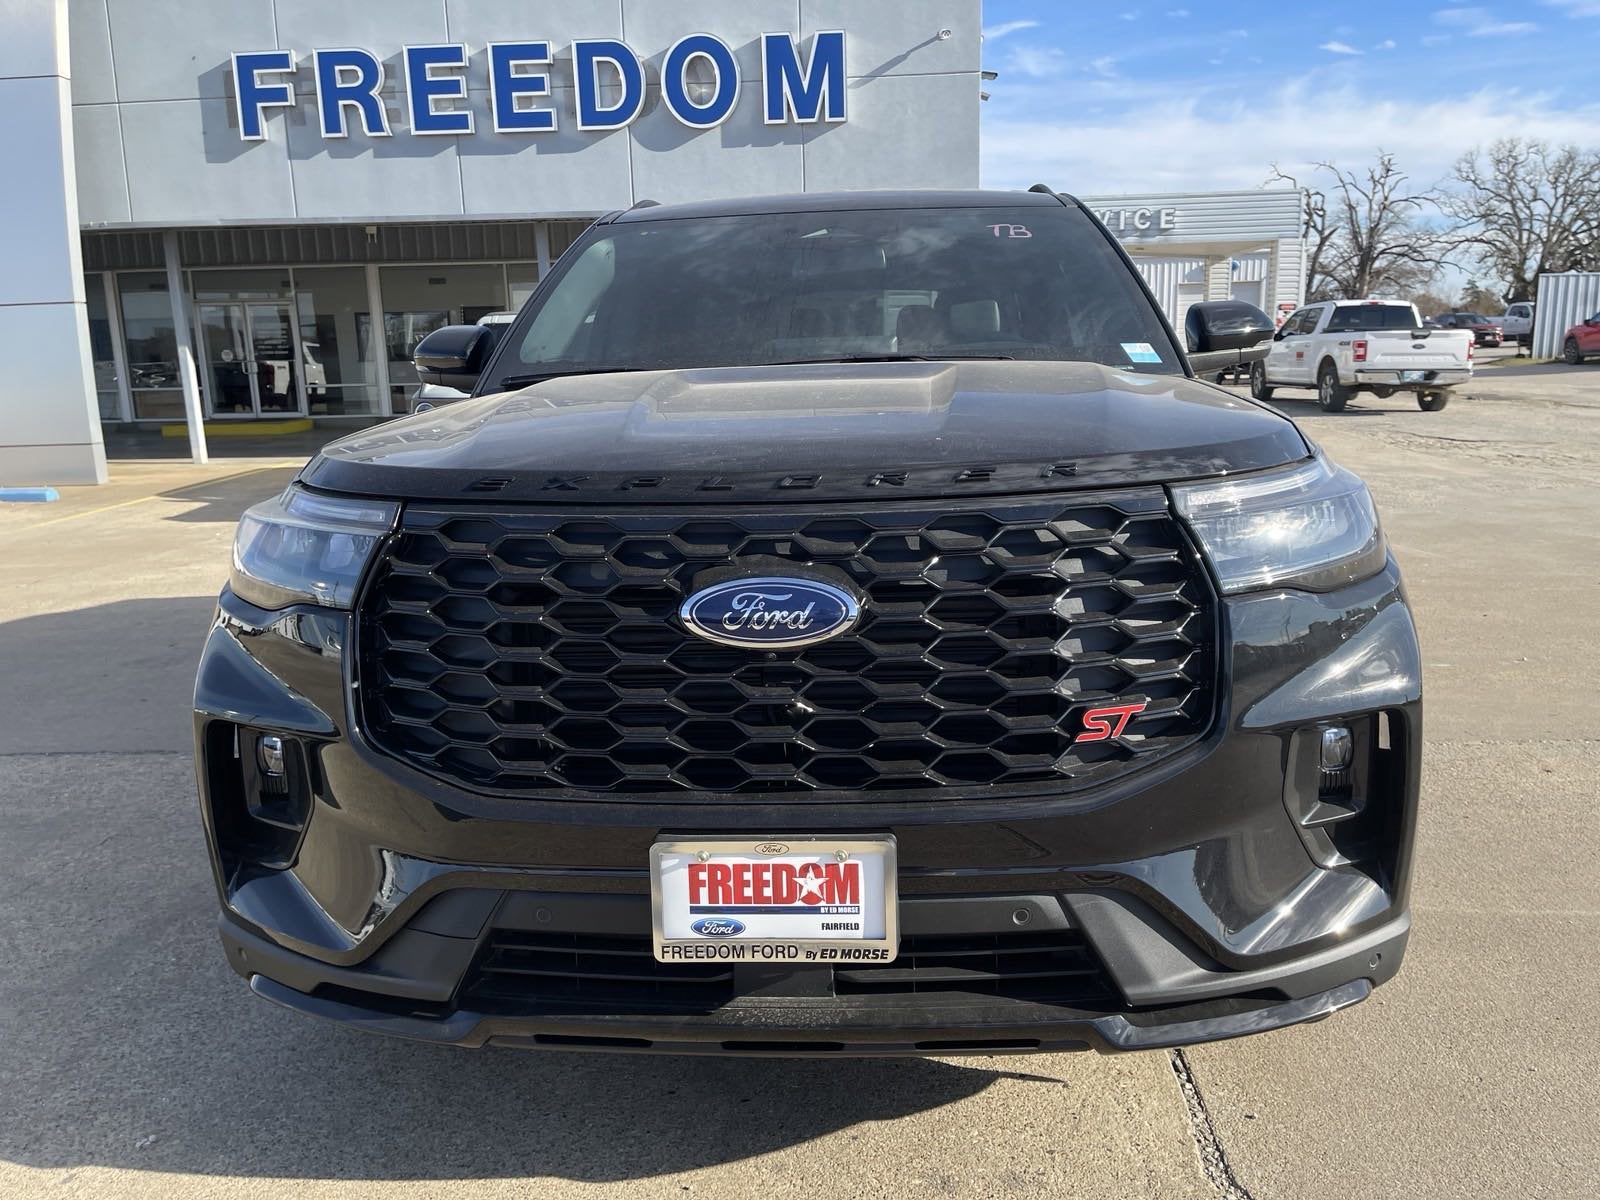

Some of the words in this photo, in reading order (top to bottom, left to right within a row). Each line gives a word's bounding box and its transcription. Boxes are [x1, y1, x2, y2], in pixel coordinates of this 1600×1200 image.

[231, 29, 848, 141] FREEDOM
[461, 462, 1079, 492] EXPLORER
[722, 592, 816, 631] Ford
[1075, 703, 1147, 742] ST
[761, 844, 783, 854] Ford
[688, 863, 859, 905] FREEDOM
[820, 906, 829, 914] BY
[829, 906, 838, 914] ED
[838, 906, 859, 914] MORSE
[702, 920, 735, 934] Ford
[821, 922, 859, 931] FAIRFIELD
[661, 945, 745, 959] FREEDOM
[752, 945, 798, 958] FORD
[806, 951, 818, 960] By
[820, 949, 837, 959] ED
[840, 949, 889, 959] MORSE
